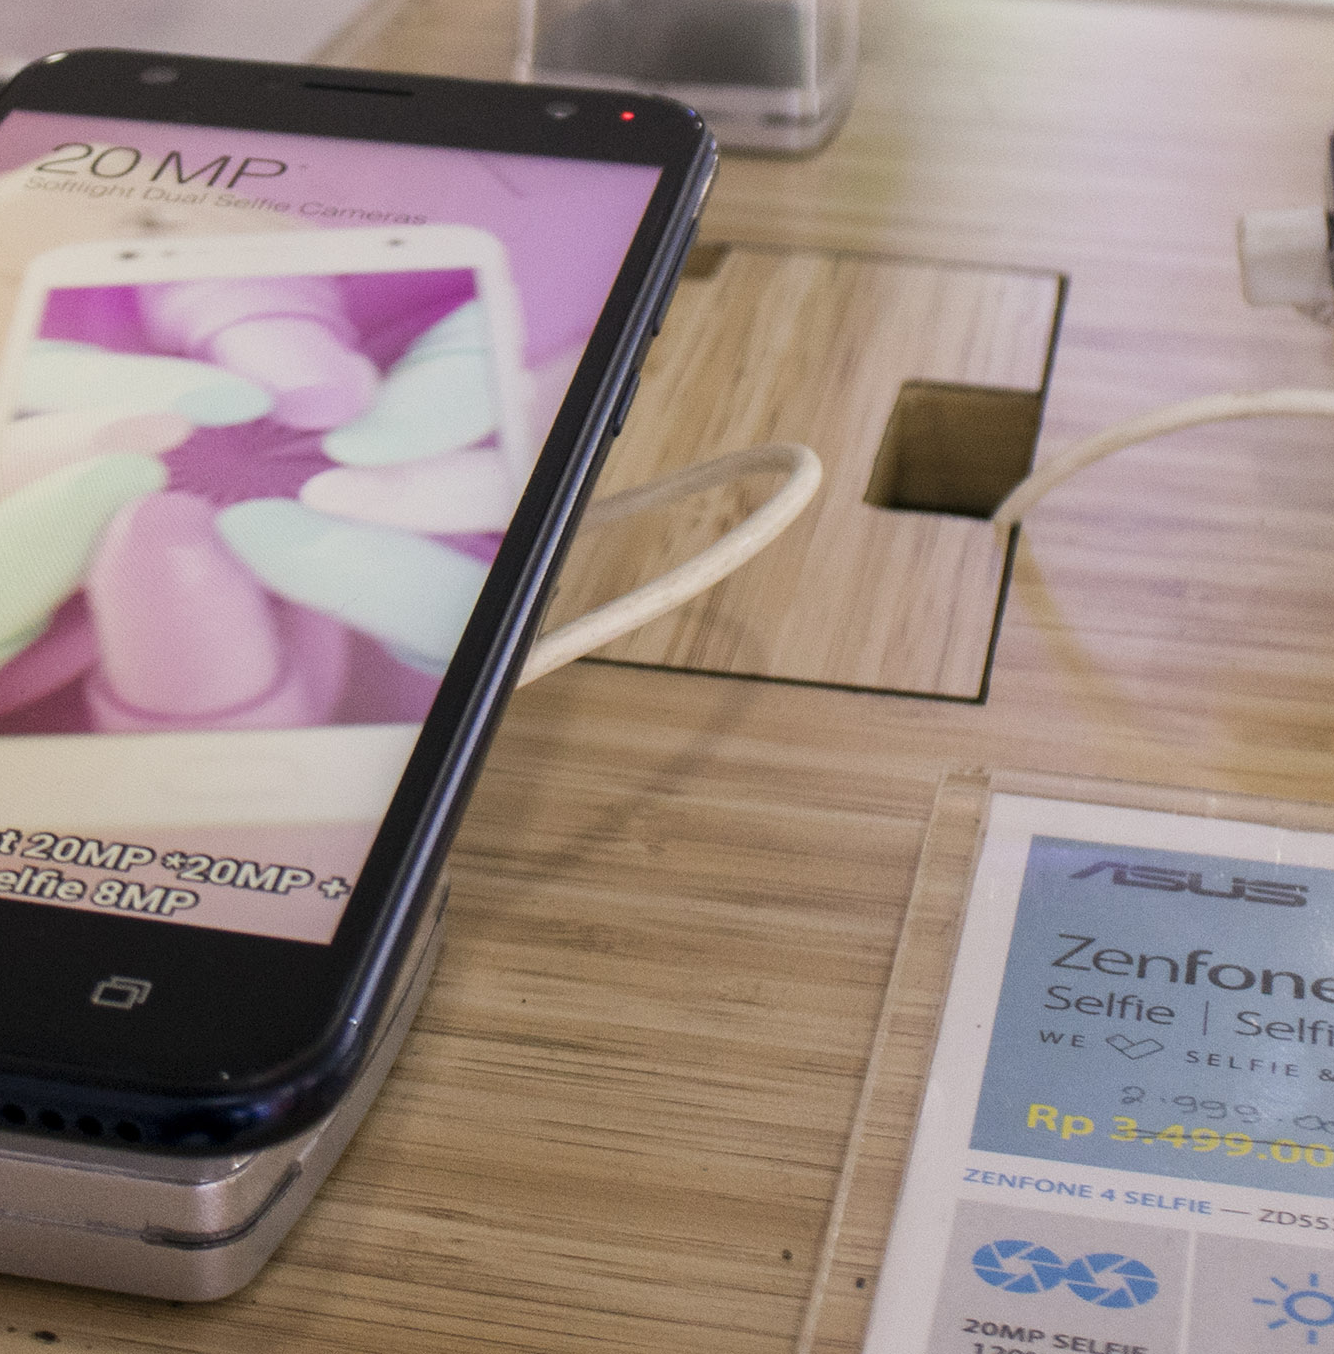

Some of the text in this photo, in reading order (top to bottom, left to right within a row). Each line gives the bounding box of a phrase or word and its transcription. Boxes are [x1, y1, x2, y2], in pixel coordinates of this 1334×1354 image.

[36, 142, 142, 179] 20
[24, 175, 429, 227] Softlight Dual Selfie Cameras
[22, 832, 154, 873] 20MP
[319, 877, 351, 899] +
[1070, 860, 1309, 907] ASUS
[91, 879, 199, 917] 8MP
[1044, 985, 1175, 1025] Selfie
[1038, 1030, 1087, 1048] WE
[1186, 1050, 1299, 1079] SELFIE
[1026, 1103, 1094, 1141] Rp
[962, 1167, 1093, 1200] ZENFONE
[1100, 1188, 1116, 1203] 4
[1124, 1191, 1213, 1216] SELFIE
[963, 1318, 1046, 1343] 20MP
